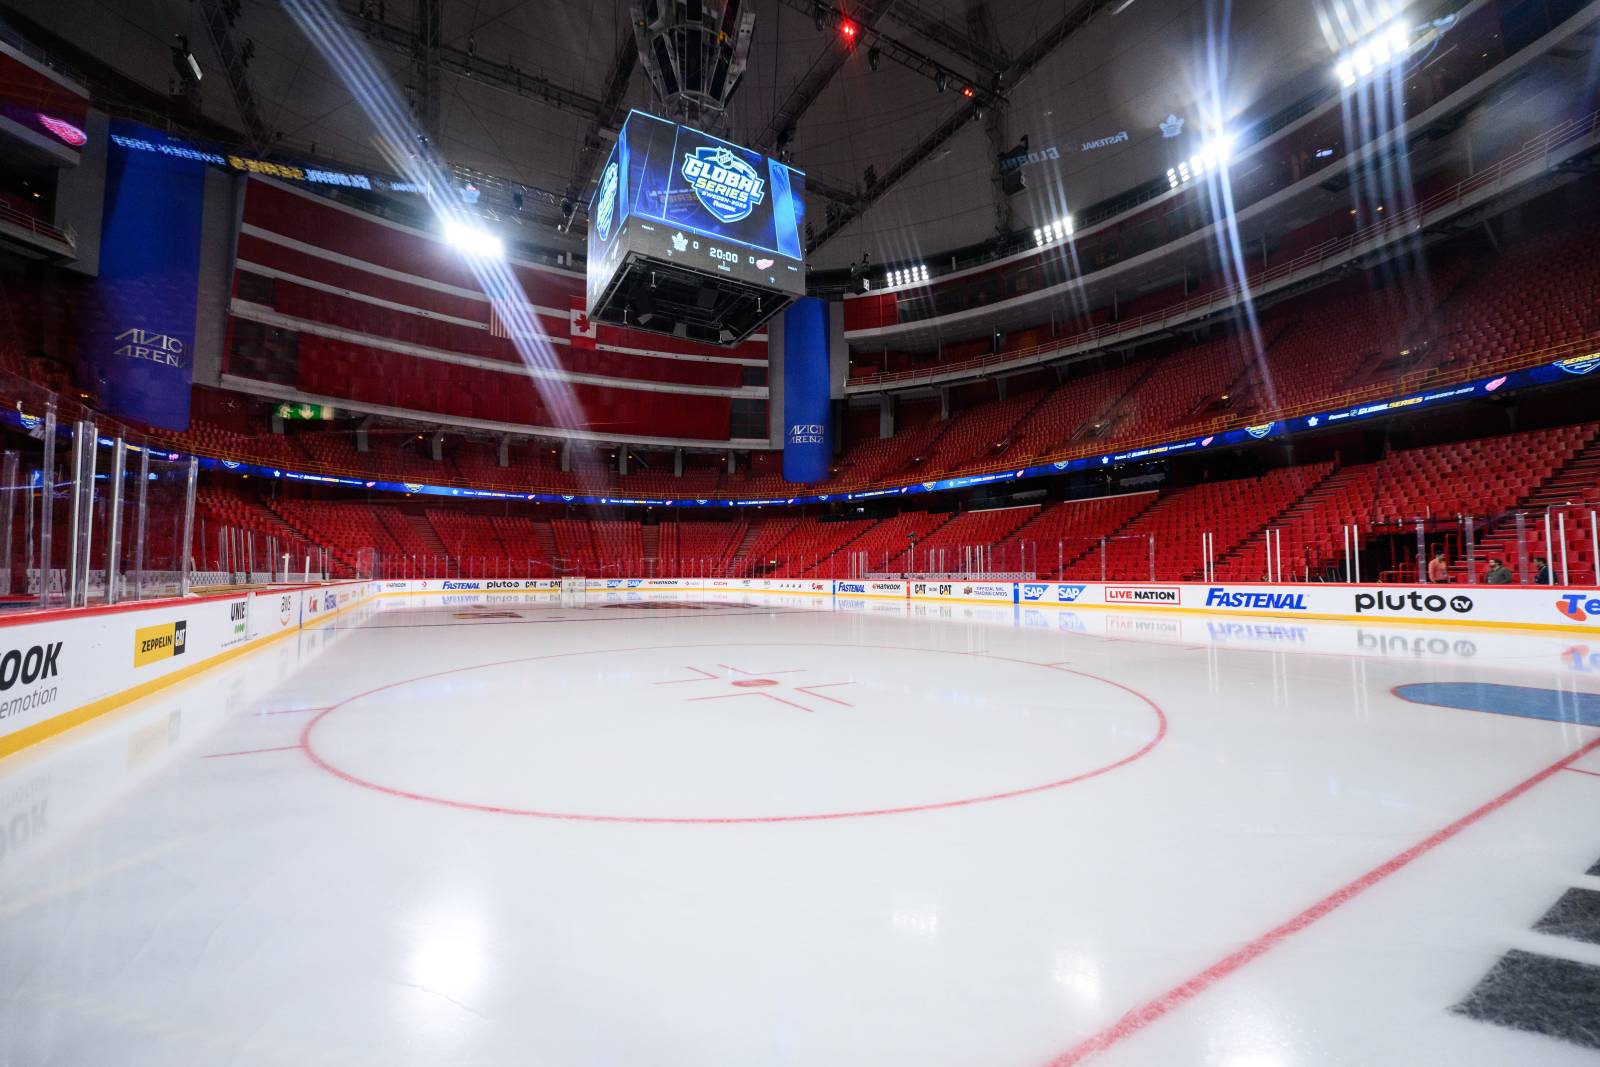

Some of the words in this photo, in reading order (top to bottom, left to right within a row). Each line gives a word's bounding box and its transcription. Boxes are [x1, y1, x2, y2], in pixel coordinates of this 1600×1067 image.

[684, 158, 761, 197] GLOBAL
[695, 177, 749, 203] SERIES
[693, 241, 699, 249] 0
[709, 247, 738, 263] 20:00
[749, 256, 755, 264] 0
[113, 345, 181, 368] AREN
[442, 581, 481, 590] FASTENAL
[486, 581, 513, 589] pluto
[838, 581, 865, 593] FASTENAL
[914, 584, 926, 594] CAT
[939, 585, 952, 595] CAT
[1025, 587, 1043, 597] SAP
[1059, 588, 1079, 599] SAP
[1109, 591, 1132, 599] LIVE
[1134, 591, 1175, 600] NATION
[1206, 587, 1307, 610] FASTENAL
[1355, 591, 1446, 613] pluto
[1562, 594, 1600, 615] Te
[141, 635, 172, 653] ZEPPELIN
[175, 629, 186, 647] CAT
[0, 641, 63, 692] OOK
[0, 685, 57, 720] emotion
